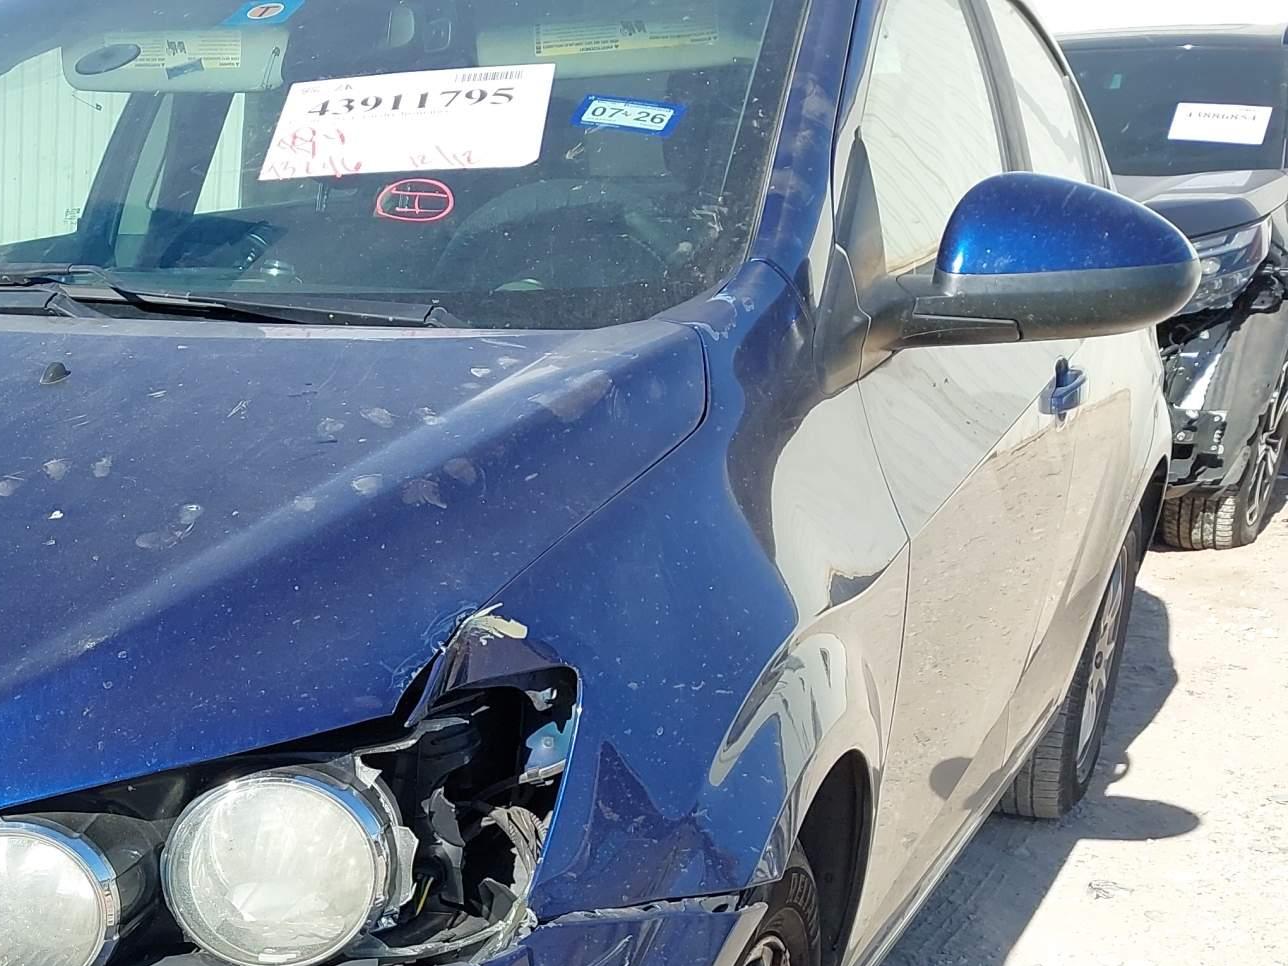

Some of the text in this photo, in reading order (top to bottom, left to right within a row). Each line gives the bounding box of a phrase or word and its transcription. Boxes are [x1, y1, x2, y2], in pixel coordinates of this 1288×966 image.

[307, 86, 516, 116] 43911795
[591, 106, 625, 119] 07
[632, 110, 667, 124] 26
